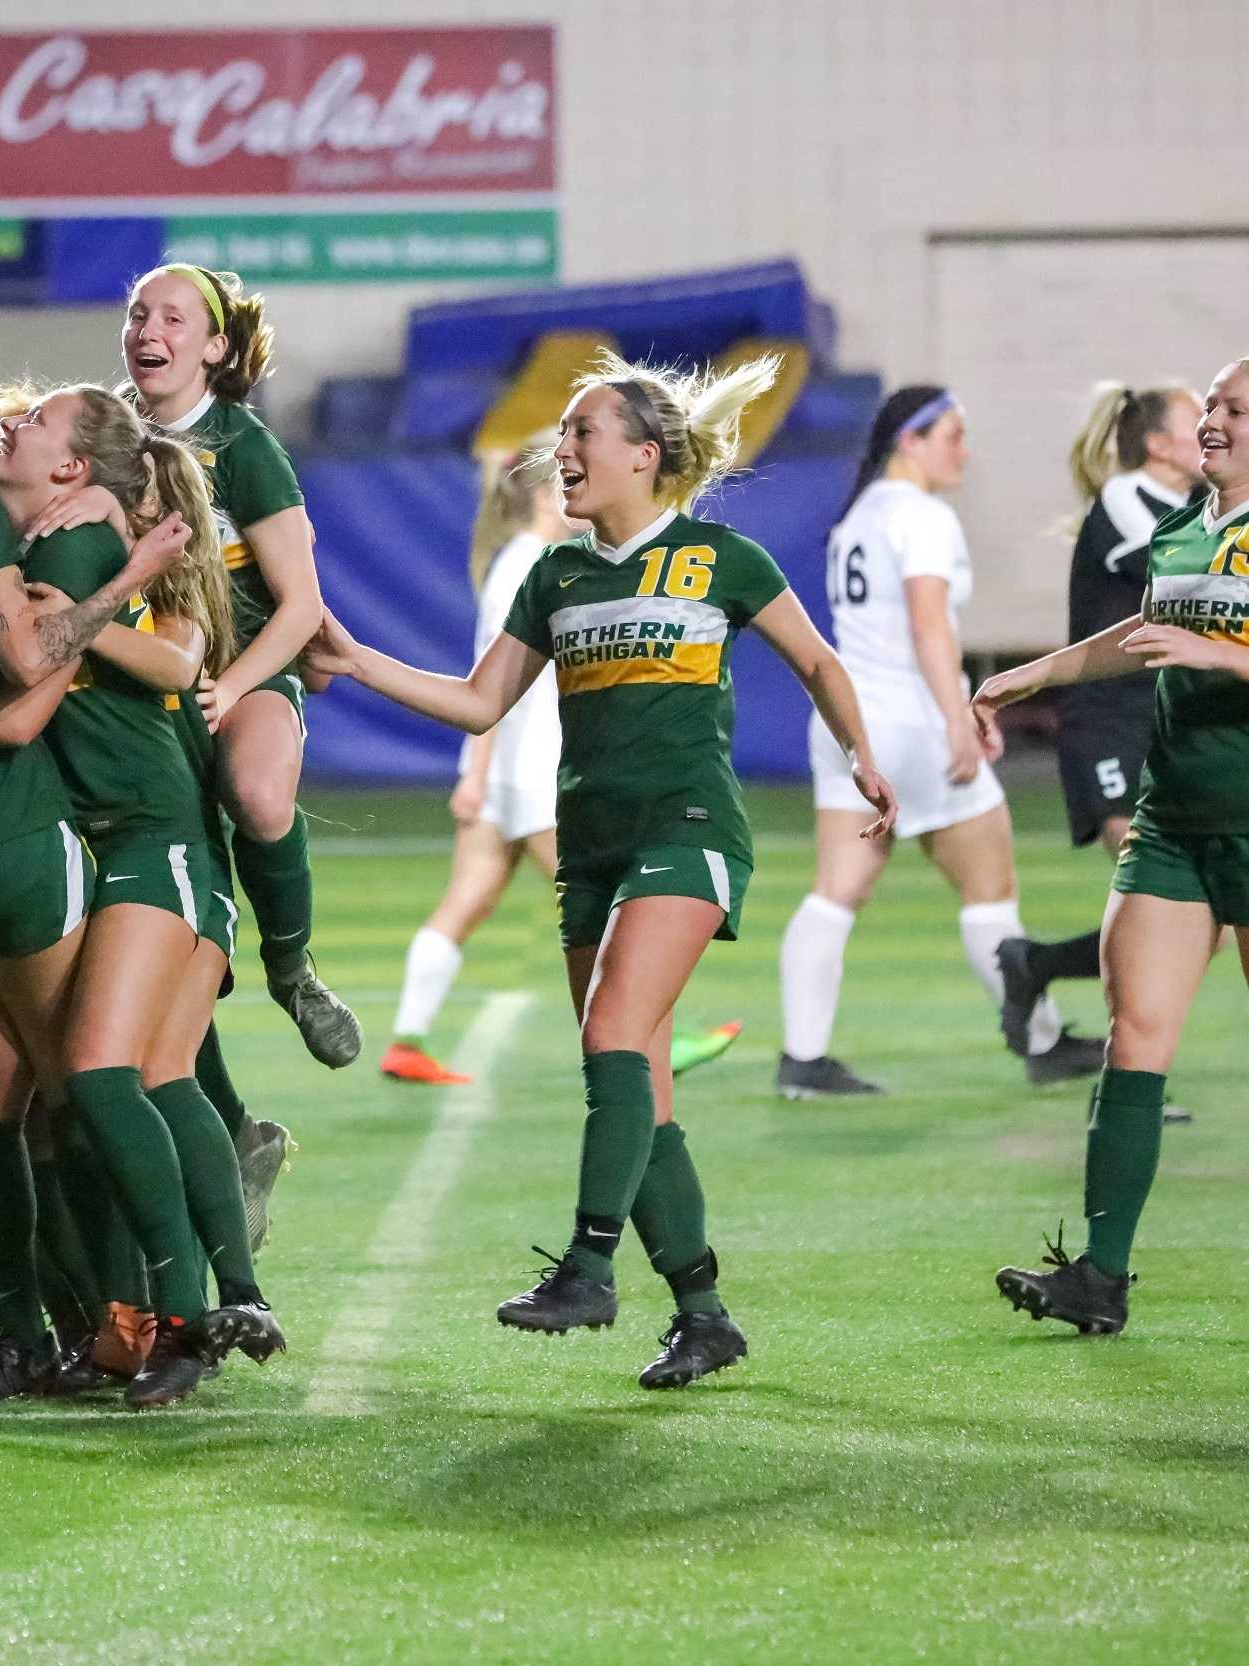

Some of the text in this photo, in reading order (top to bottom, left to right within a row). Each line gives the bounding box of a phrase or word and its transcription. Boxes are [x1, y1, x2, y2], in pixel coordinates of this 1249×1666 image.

[171, 56, 548, 168] Calabria
[636, 545, 717, 601] 16
[554, 621, 686, 651] ORTHERN
[1095, 757, 1127, 800] 5
